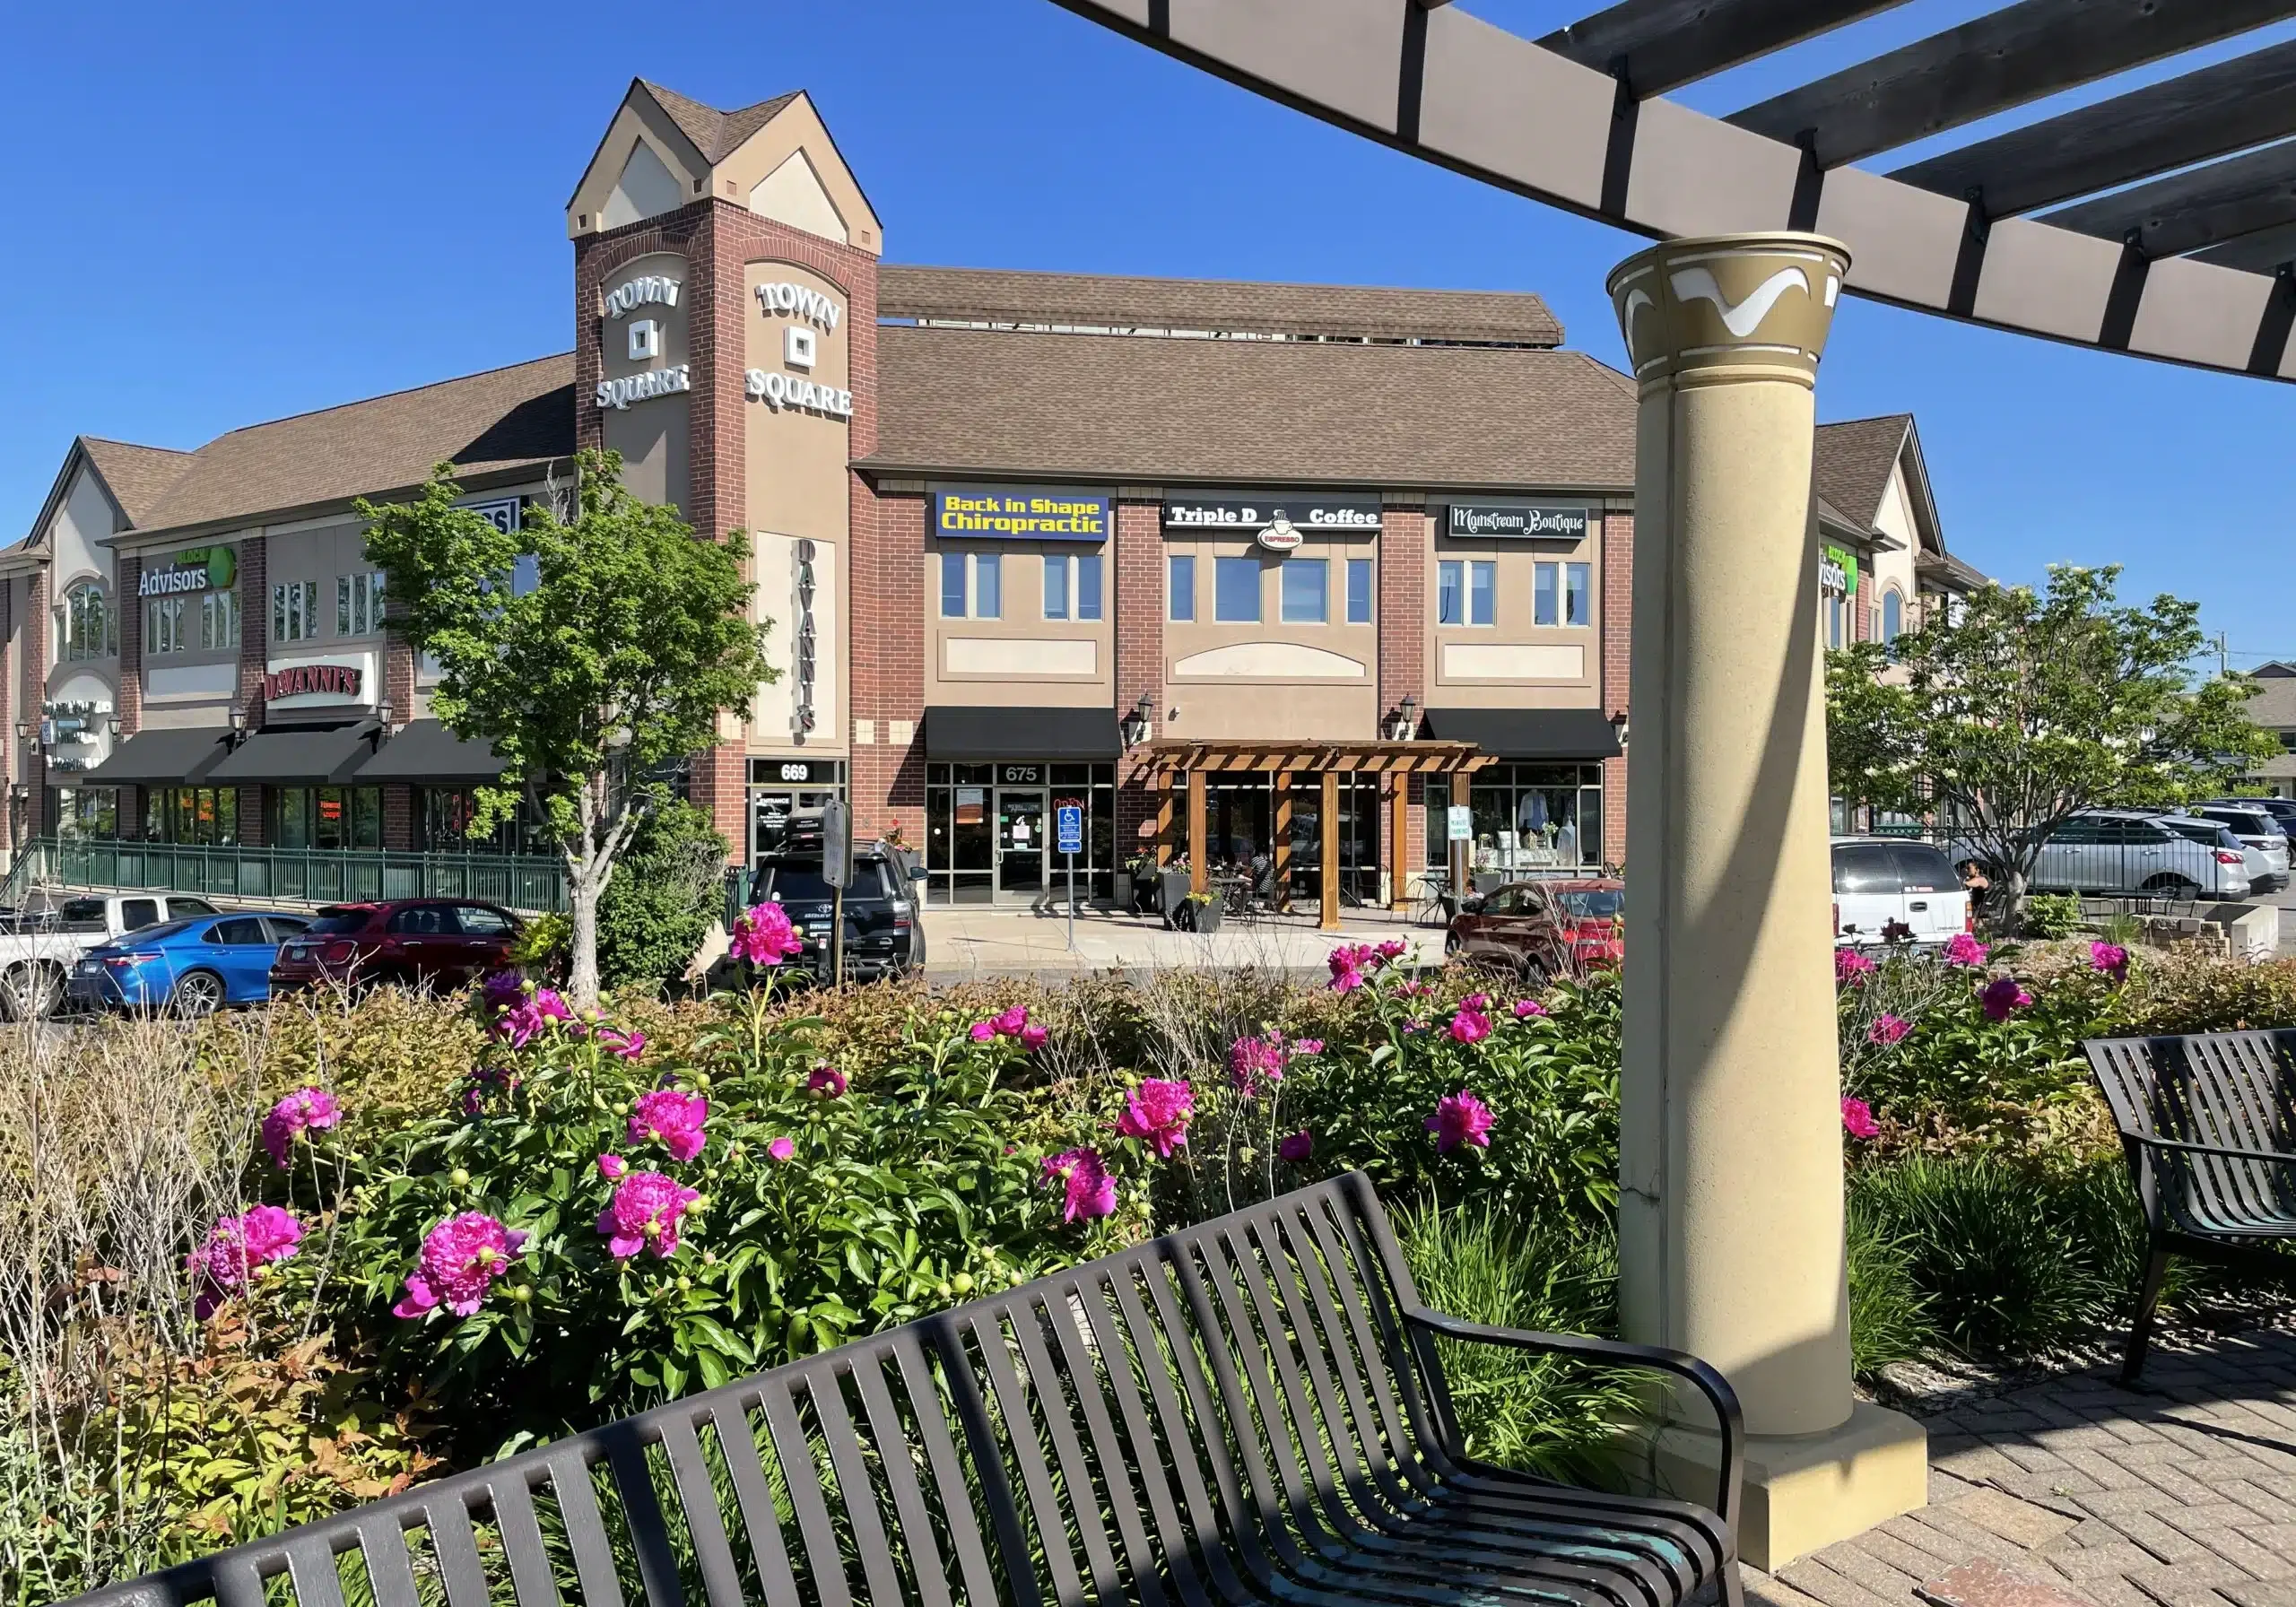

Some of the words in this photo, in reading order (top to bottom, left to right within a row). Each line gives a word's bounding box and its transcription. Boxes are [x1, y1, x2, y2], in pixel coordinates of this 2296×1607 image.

[605, 275, 682, 320] TOWN
[756, 282, 842, 329] TOWN
[596, 364, 690, 410] SQUARE
[746, 368, 853, 416] SQUARE
[944, 496, 1001, 512] Back
[1004, 498, 1026, 513] in
[1031, 499, 1100, 517] Shape
[1171, 507, 1237, 526] Triple
[1241, 508, 1257, 523] D
[1309, 508, 1378, 524] Coffee
[942, 512, 1103, 534] Chiropractic
[1453, 508, 1524, 534] Mainstream
[1523, 509, 1584, 535] Boutique
[1264, 535, 1300, 543] ESPRESSO
[138, 562, 206, 596] Advisors
[781, 764, 808, 781] 669
[1005, 767, 1038, 781] 675
